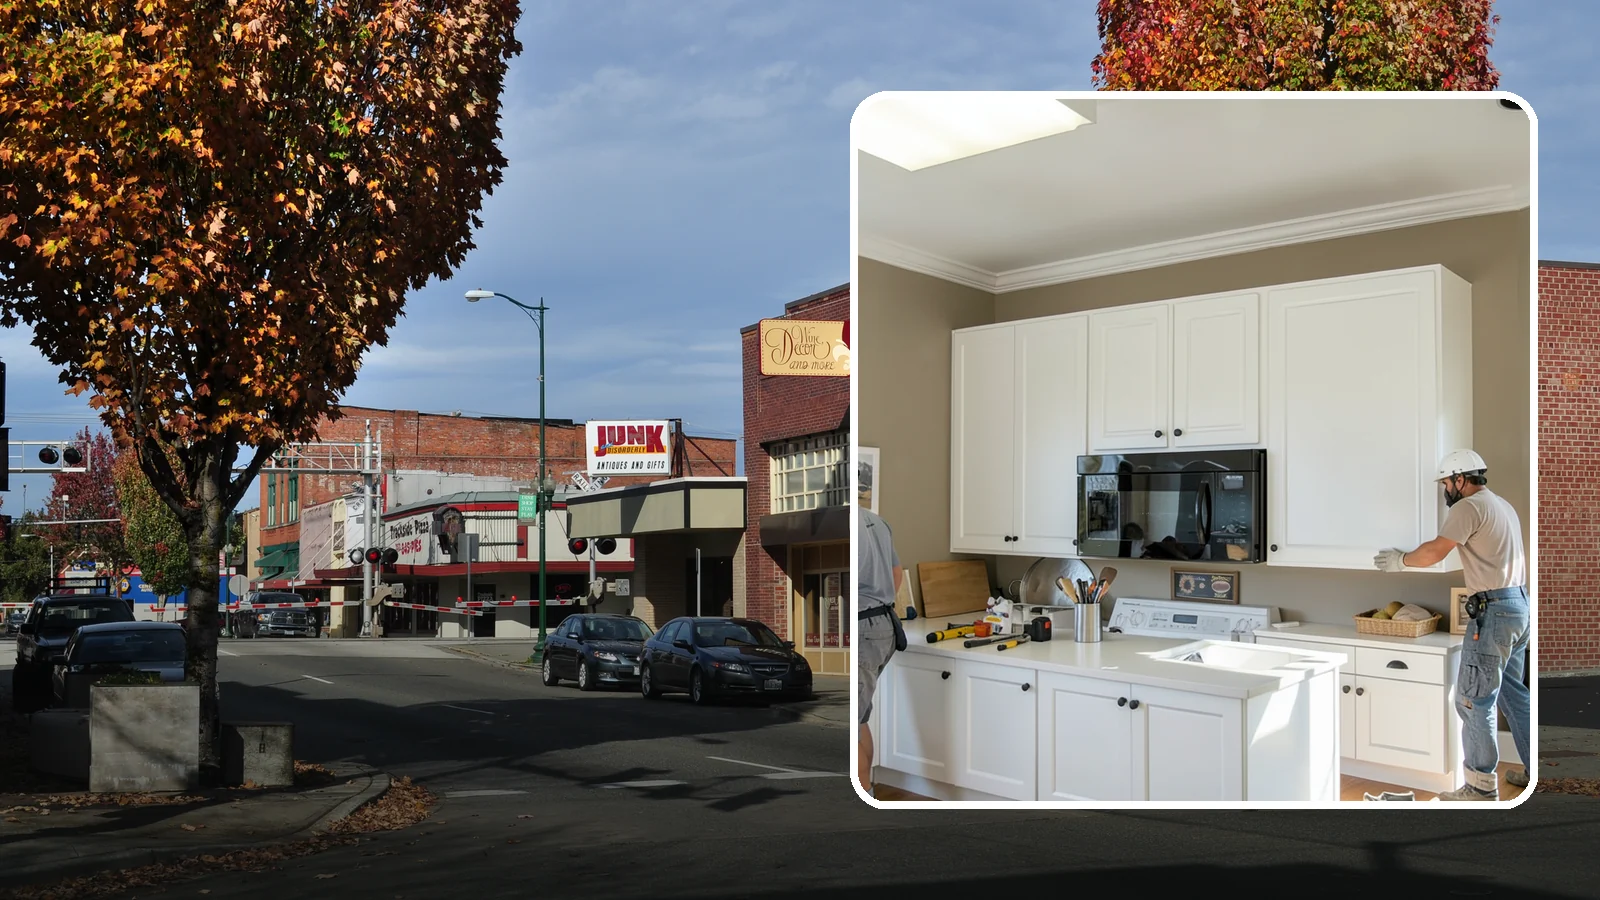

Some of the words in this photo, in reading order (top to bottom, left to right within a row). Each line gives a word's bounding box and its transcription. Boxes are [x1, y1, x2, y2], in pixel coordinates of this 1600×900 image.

[595, 425, 665, 457] JUNK
[607, 446, 646, 454] DISORDERLY
[596, 461, 628, 470] ANTIQUES
[631, 461, 644, 470] AND
[646, 460, 666, 469] GIFTS
[414, 519, 429, 535] Pizza
